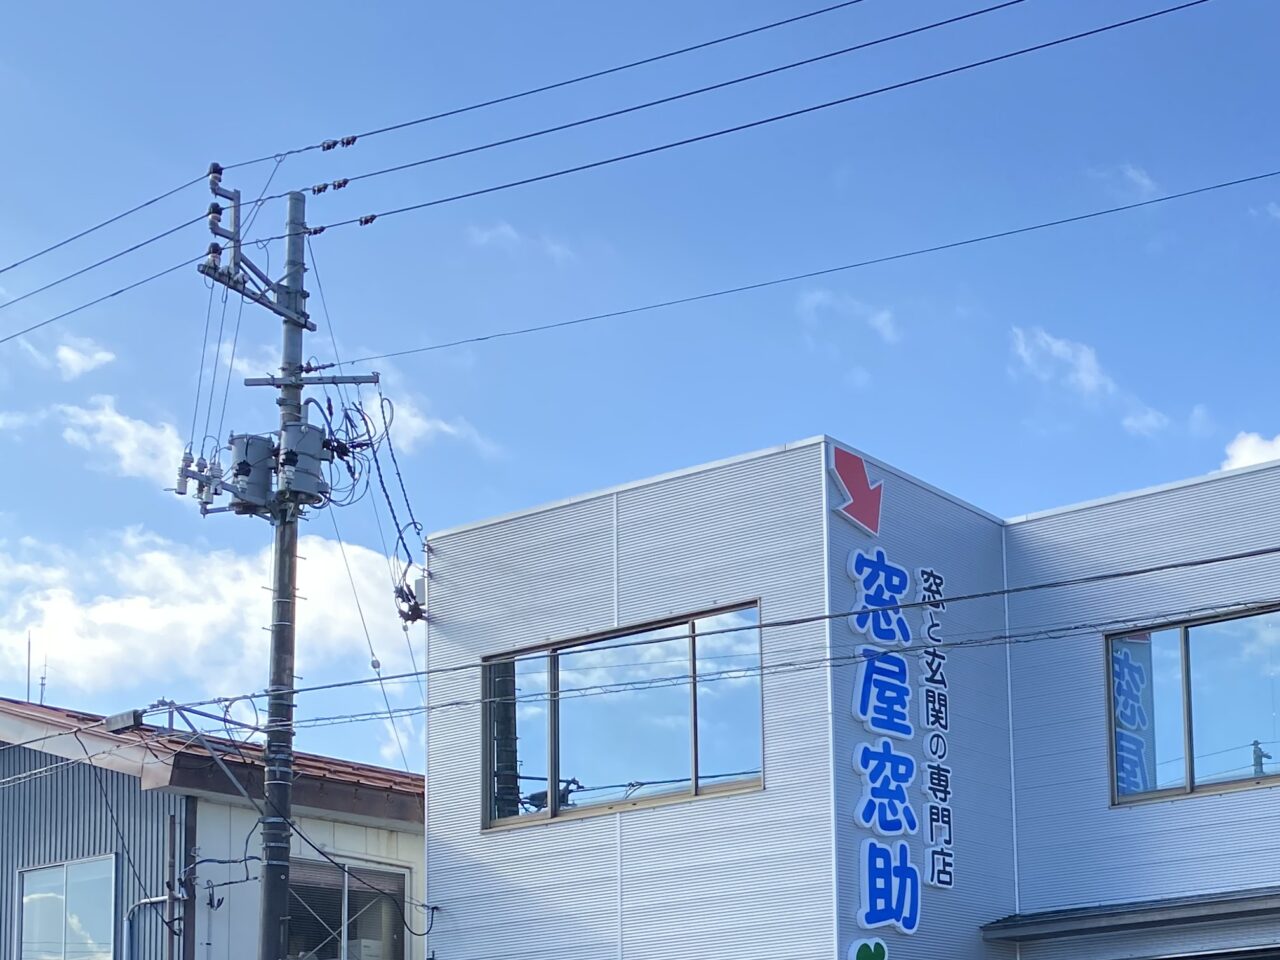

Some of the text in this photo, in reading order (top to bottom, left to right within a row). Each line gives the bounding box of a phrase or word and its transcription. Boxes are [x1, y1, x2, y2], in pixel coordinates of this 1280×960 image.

[854, 549, 919, 931] 窓屋窓助
[920, 569, 953, 887] 窓と玄関の専門店
